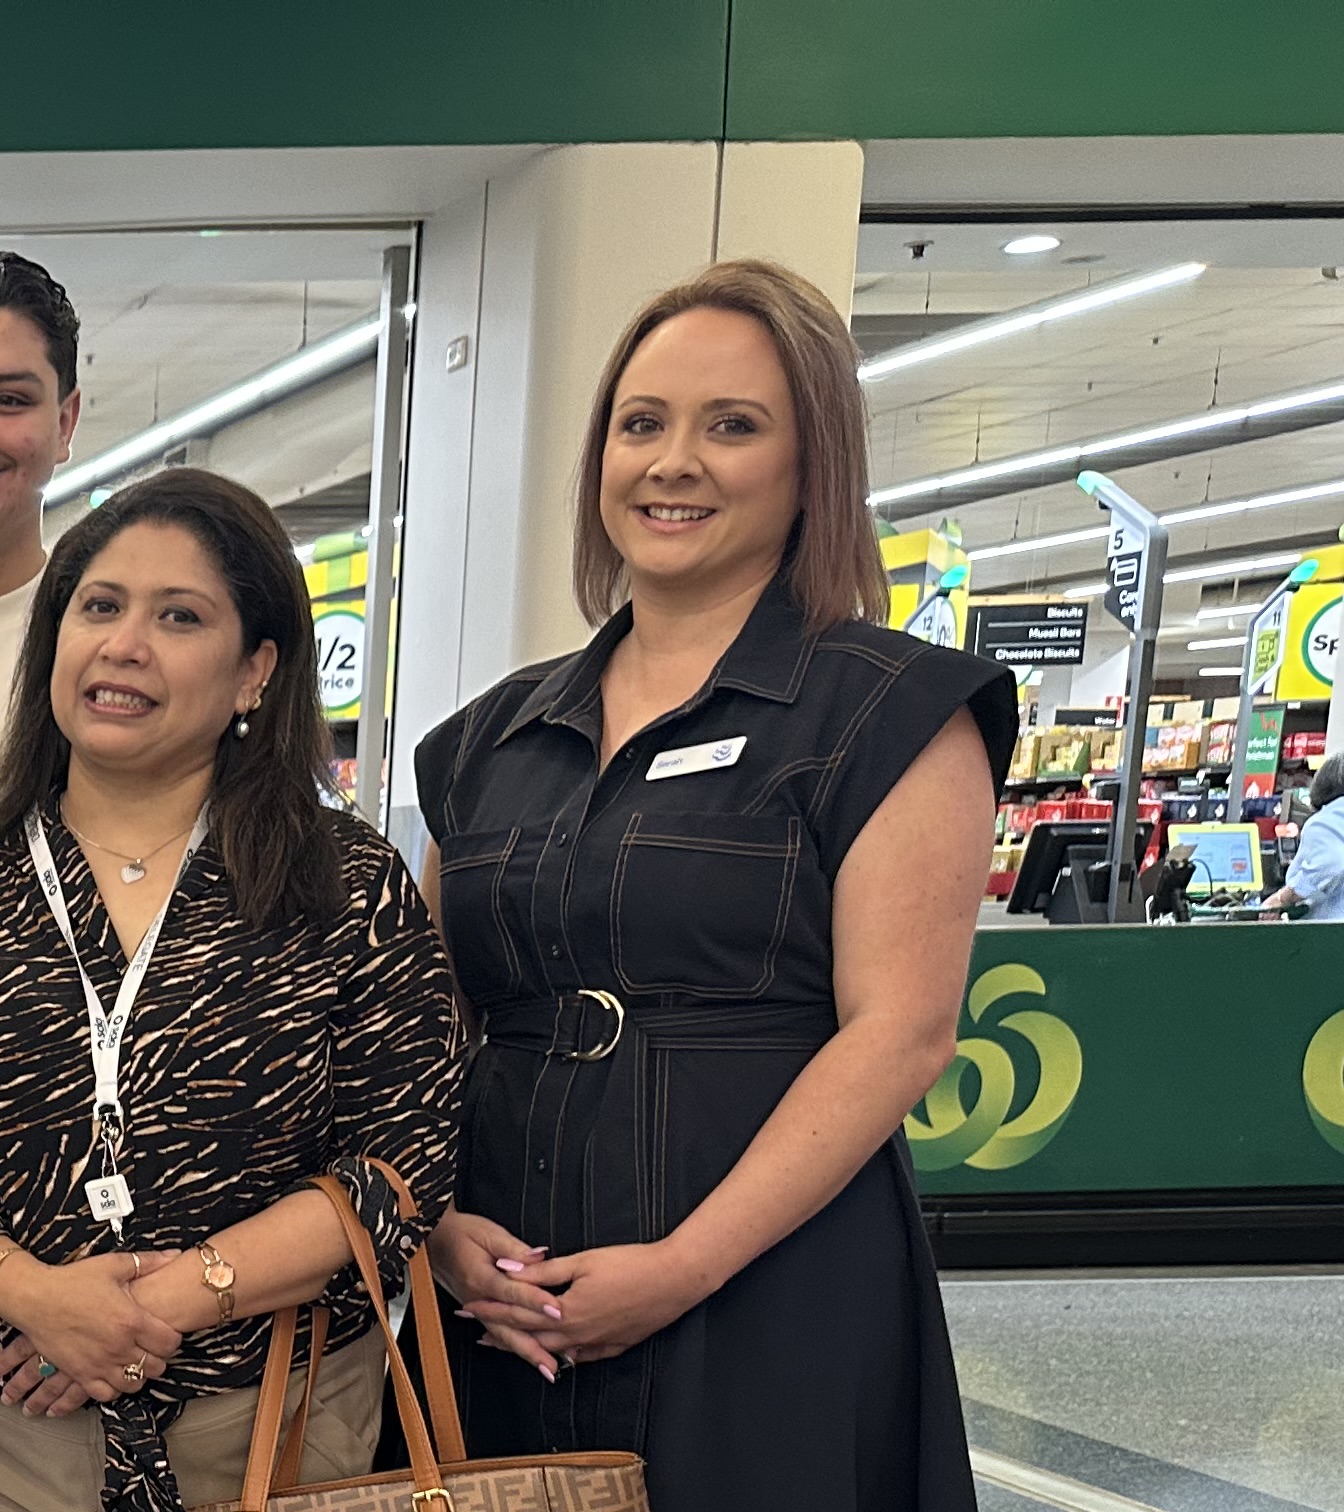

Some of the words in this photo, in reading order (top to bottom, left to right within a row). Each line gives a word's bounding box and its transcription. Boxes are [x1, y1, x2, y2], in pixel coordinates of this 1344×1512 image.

[1113, 528, 1125, 550] 5
[1046, 606, 1084, 619] Biscuits
[1273, 610, 1282, 627] 11
[922, 615, 933, 632] 12
[994, 648, 1043, 661] Chocolate
[321, 673, 355, 689] rice
